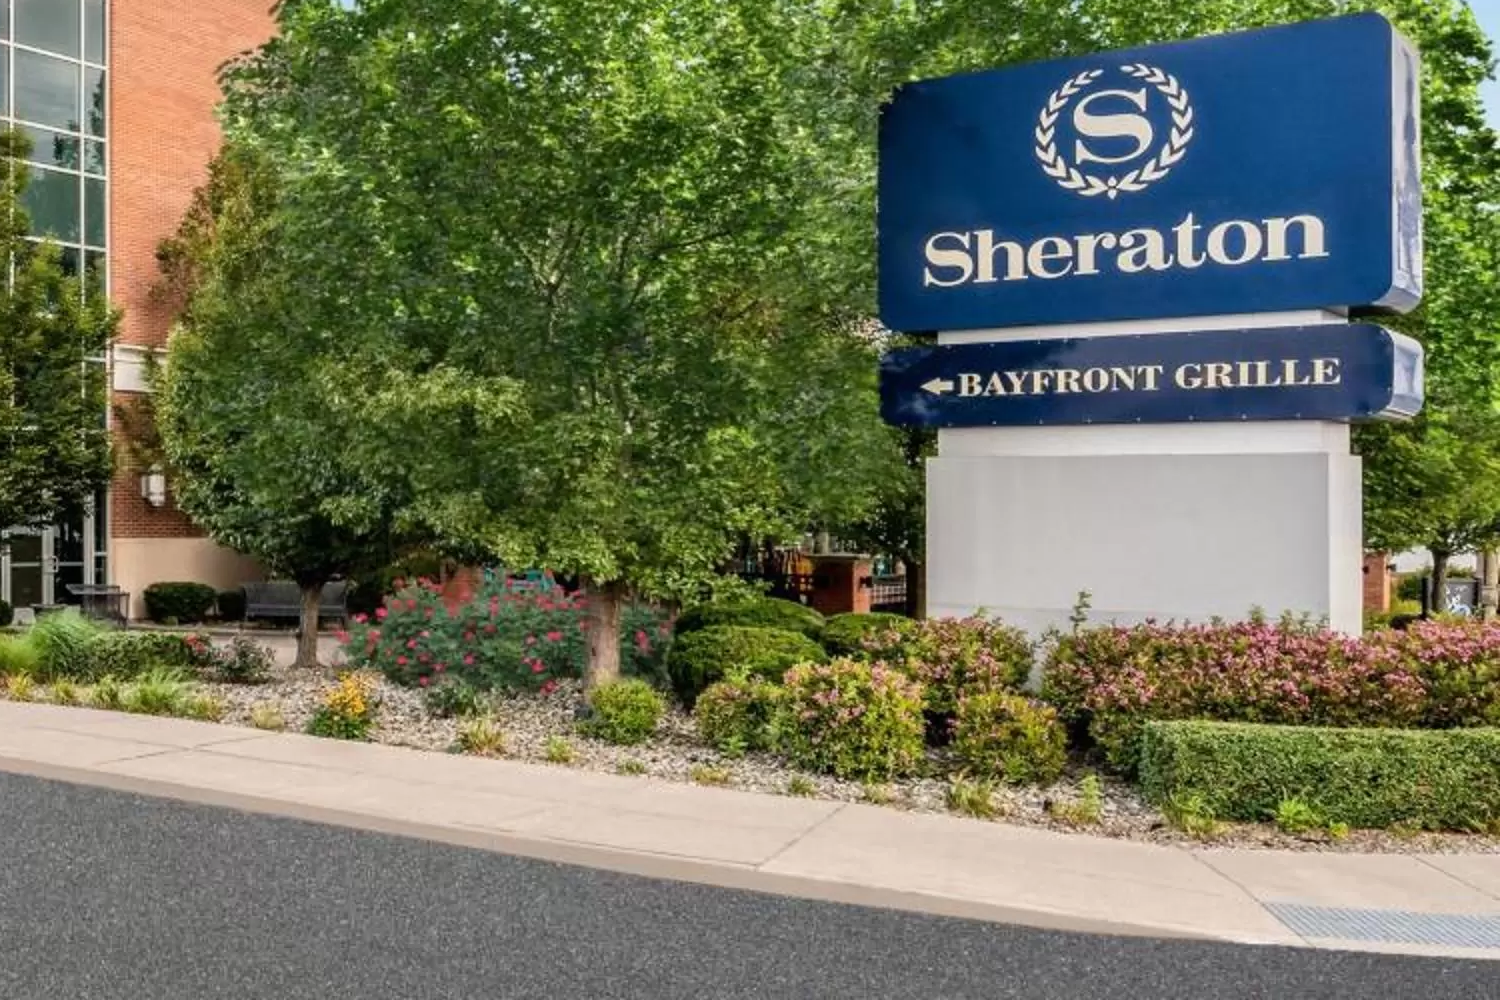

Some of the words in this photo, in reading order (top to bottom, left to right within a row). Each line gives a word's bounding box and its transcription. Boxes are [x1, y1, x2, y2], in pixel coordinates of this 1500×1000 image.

[1072, 87, 1154, 165] S
[922, 211, 1330, 288] Sheraton
[957, 365, 1163, 398] BAYFRONT
[1175, 357, 1342, 390] GRILLE
